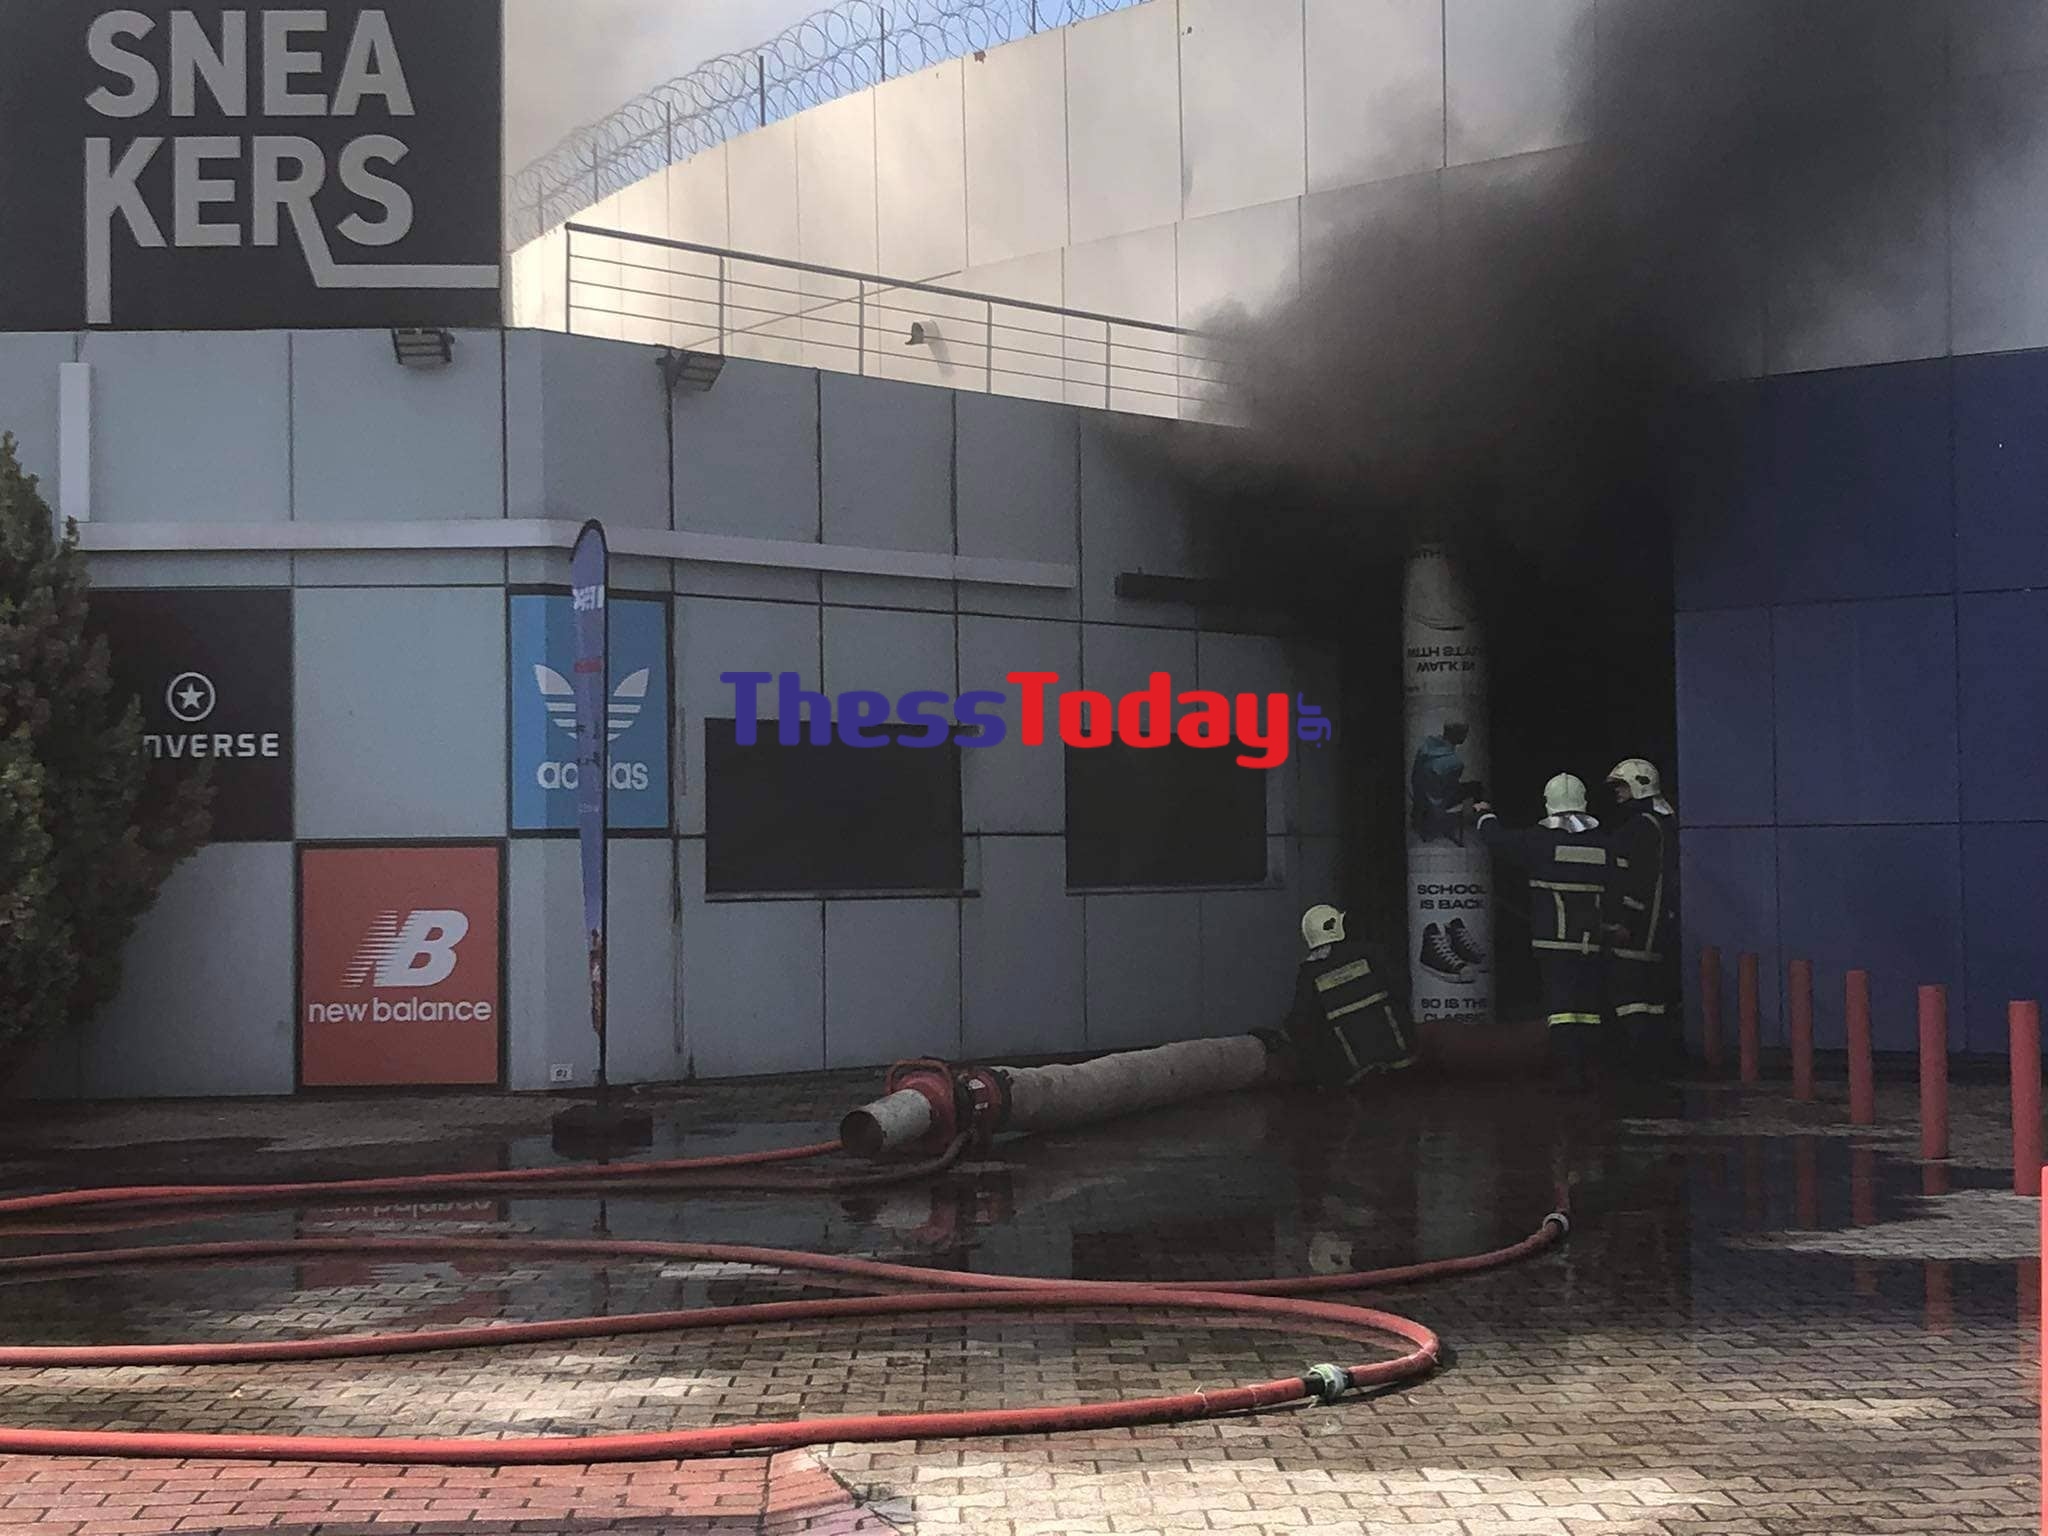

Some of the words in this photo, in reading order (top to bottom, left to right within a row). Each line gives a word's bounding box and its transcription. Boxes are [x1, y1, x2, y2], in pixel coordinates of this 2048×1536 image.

[85, 9, 415, 118] SNEA
[85, 134, 500, 324] KERS
[143, 733, 280, 758] NVERSE
[537, 761, 649, 790] adas
[1420, 899, 1434, 910] IS
[309, 1001, 367, 1023] new
[373, 997, 492, 1022] balance
[1421, 998, 1441, 1009] SO
[1445, 998, 1460, 1009] IS
